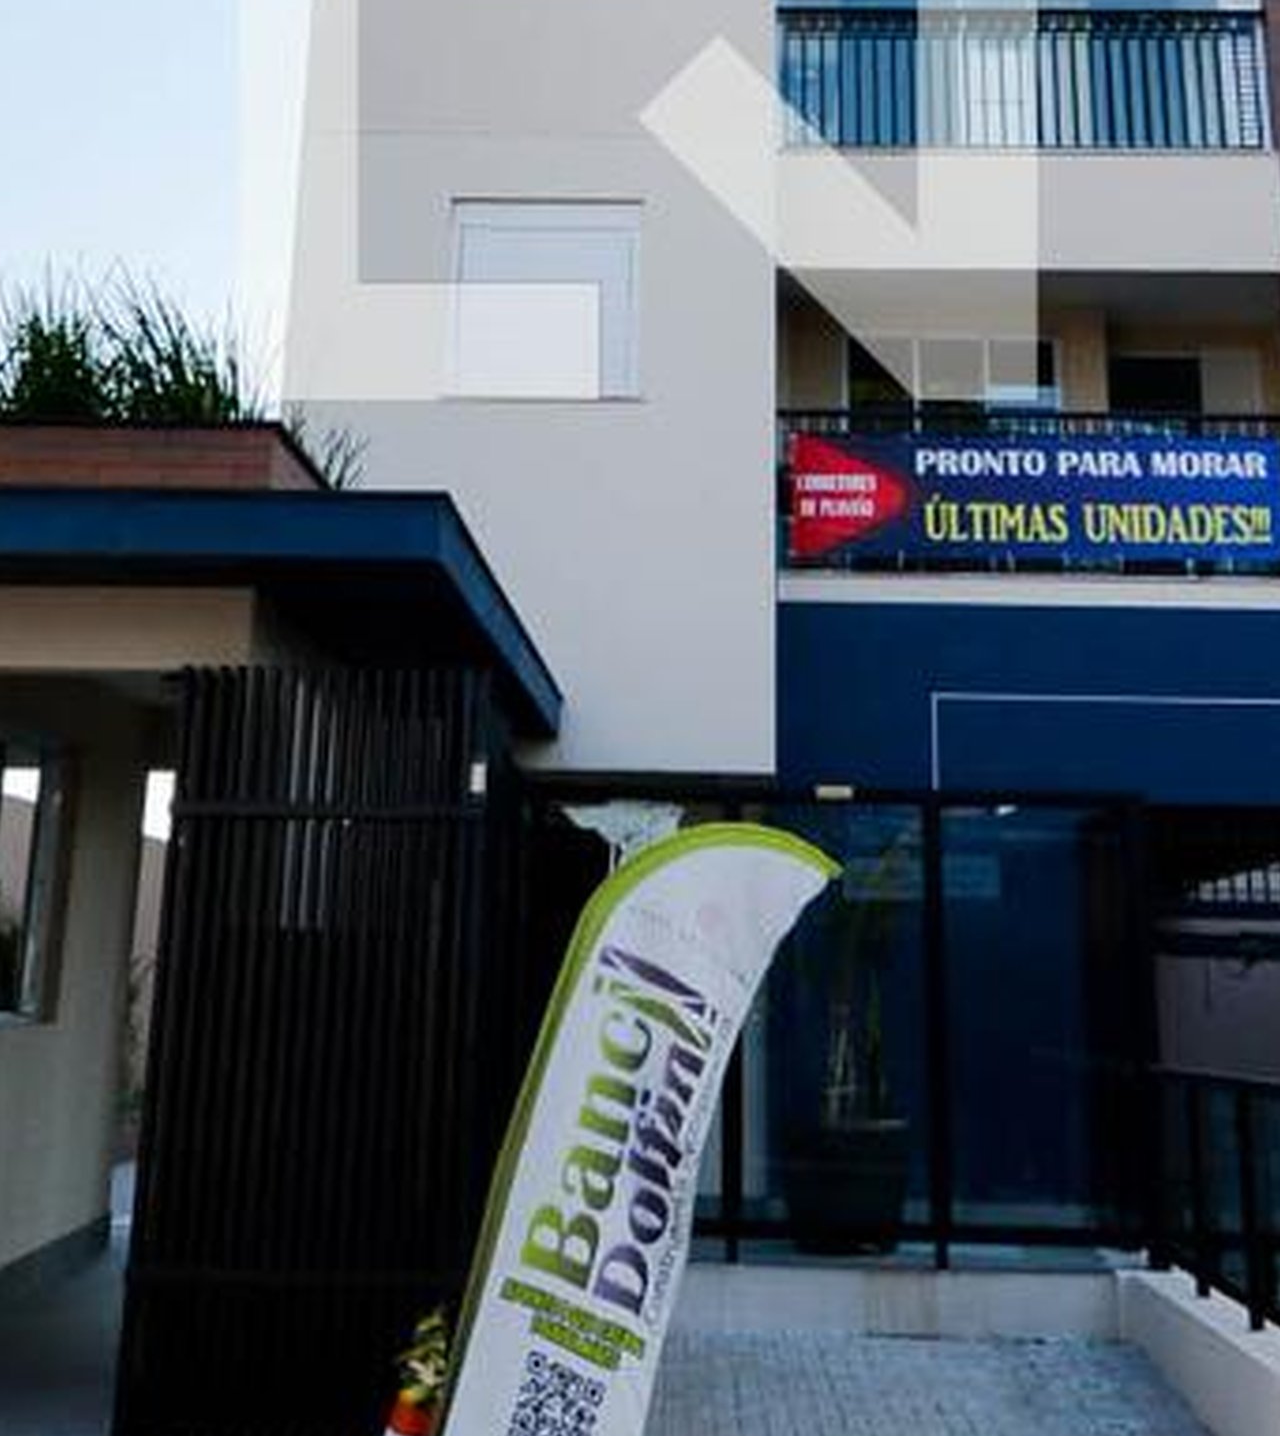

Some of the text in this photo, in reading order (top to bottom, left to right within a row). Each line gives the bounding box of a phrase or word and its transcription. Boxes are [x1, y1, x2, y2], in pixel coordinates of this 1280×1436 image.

[915, 449, 1267, 479] PRONTO PARA MORAR
[924, 492, 1272, 545] ÚLTIMAS UNIDADES!!!
